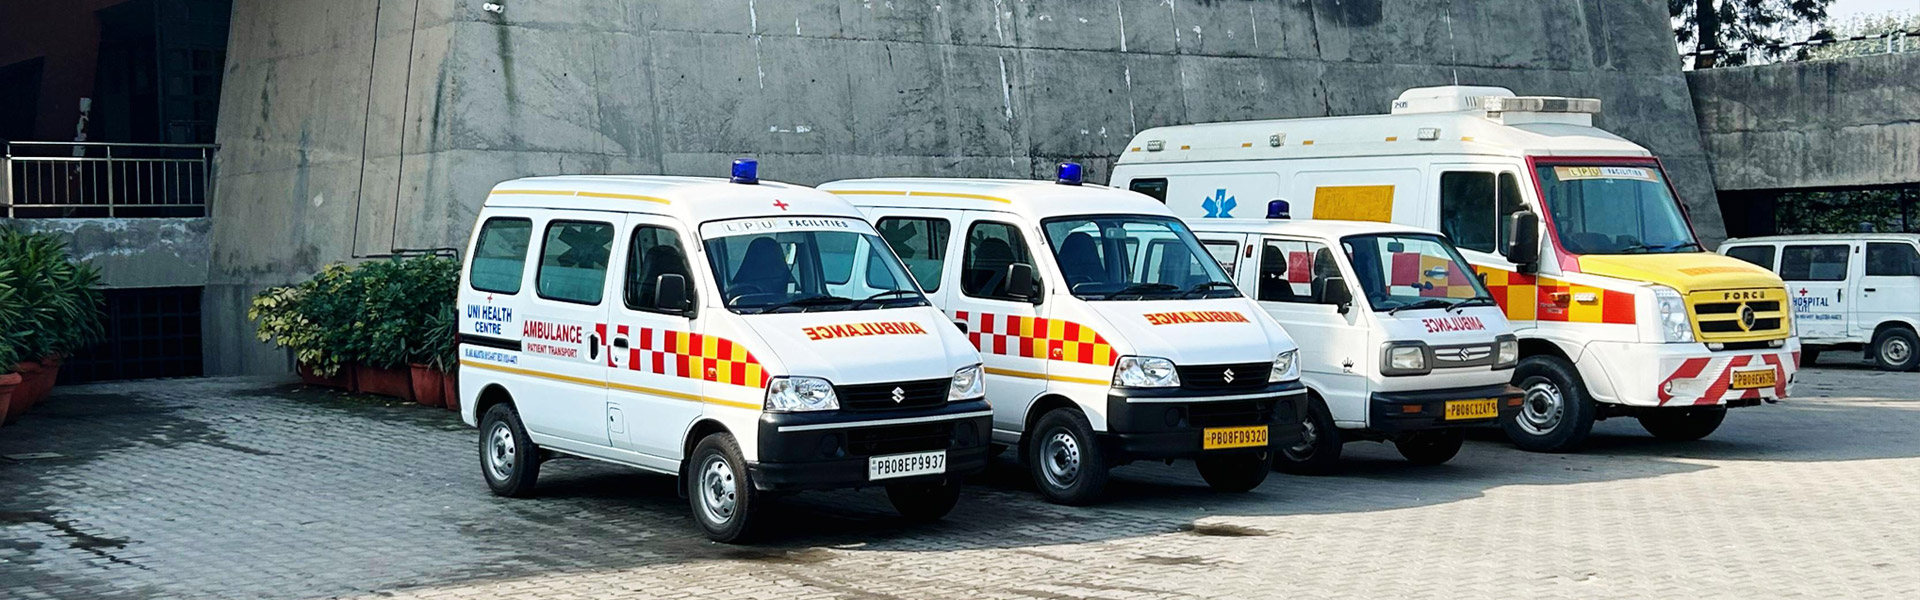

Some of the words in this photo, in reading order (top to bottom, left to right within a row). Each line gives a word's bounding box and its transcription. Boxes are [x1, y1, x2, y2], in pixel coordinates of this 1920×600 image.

[788, 219, 849, 228] FACILITIES
[467, 304, 481, 319] UNI
[482, 305, 513, 323] HEALTH
[475, 321, 502, 335] CENTRE
[523, 320, 582, 344] AMBULANCE
[527, 343, 547, 354] PATIENT
[548, 345, 578, 358] TRANSPORT
[1211, 429, 1267, 445] PB08FD9320
[878, 454, 944, 475] PB08EP9937
